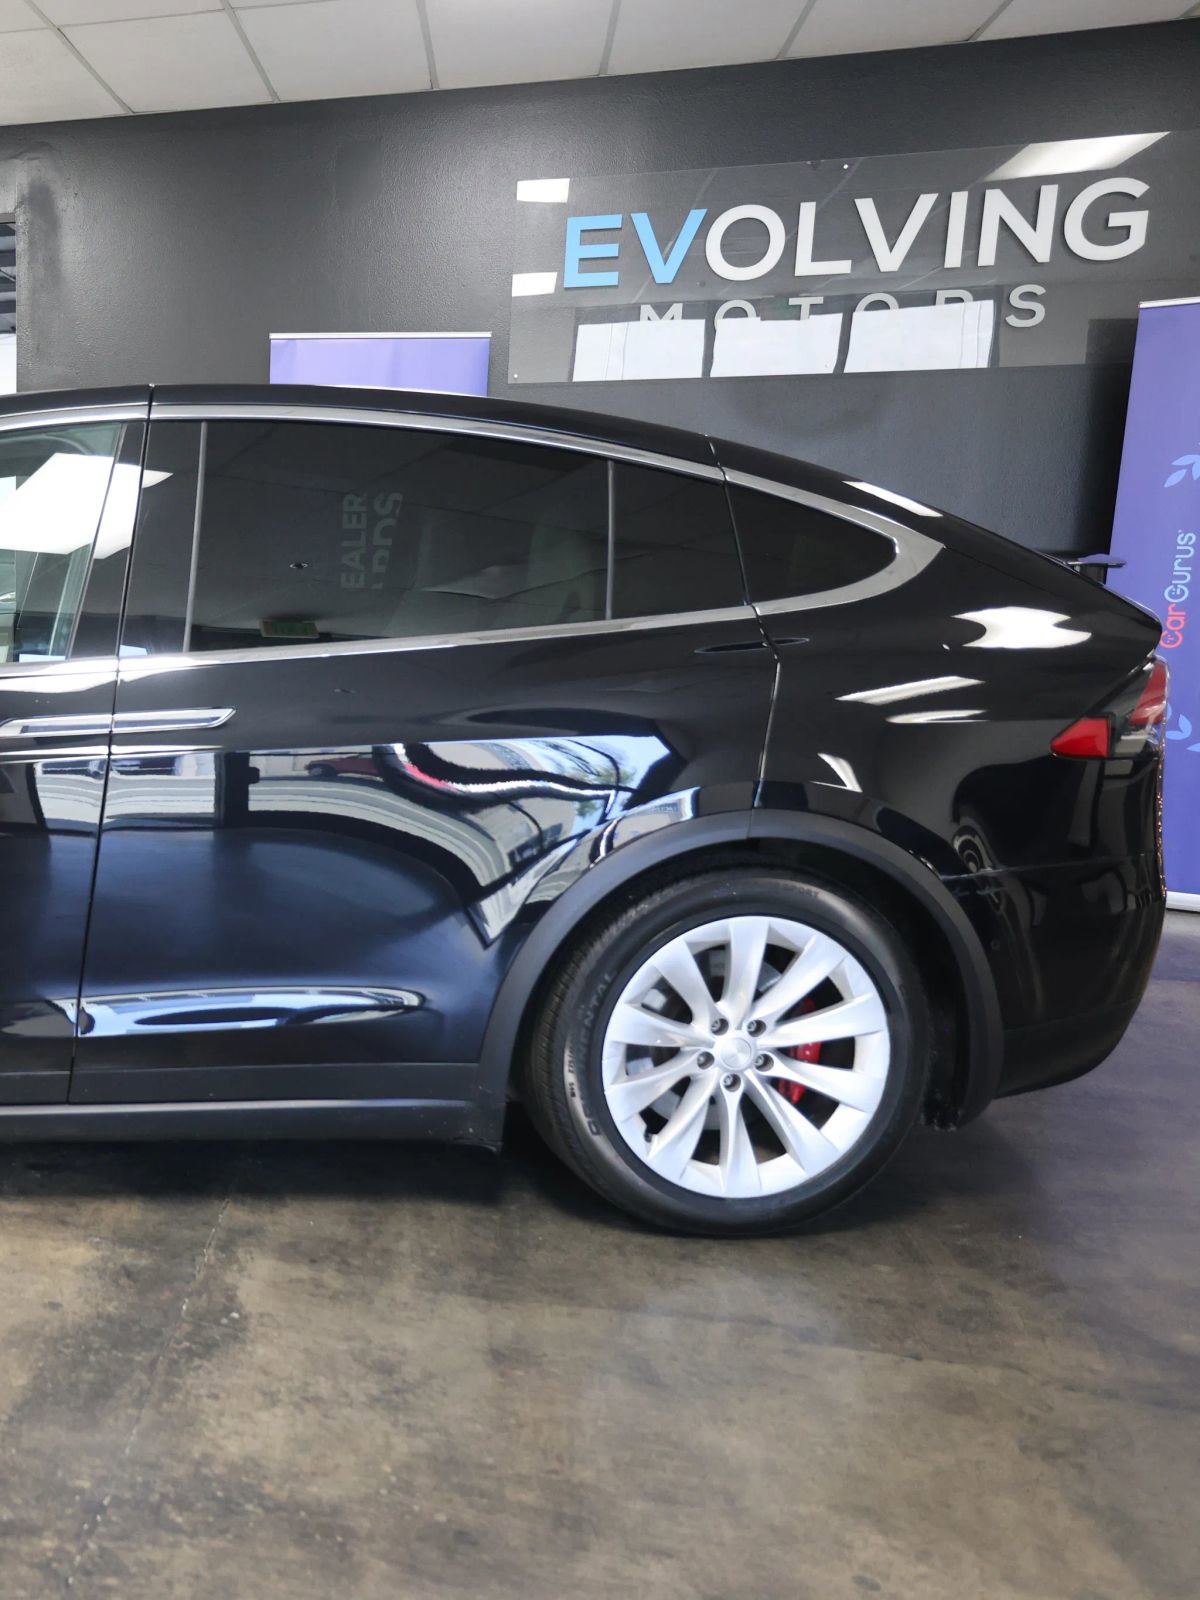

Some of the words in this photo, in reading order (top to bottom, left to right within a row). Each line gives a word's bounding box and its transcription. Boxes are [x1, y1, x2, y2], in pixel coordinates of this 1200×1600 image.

[563, 177, 1150, 288] EVOLVING
[340, 493, 367, 589] EALER
[1159, 531, 1196, 649] CarGurus
